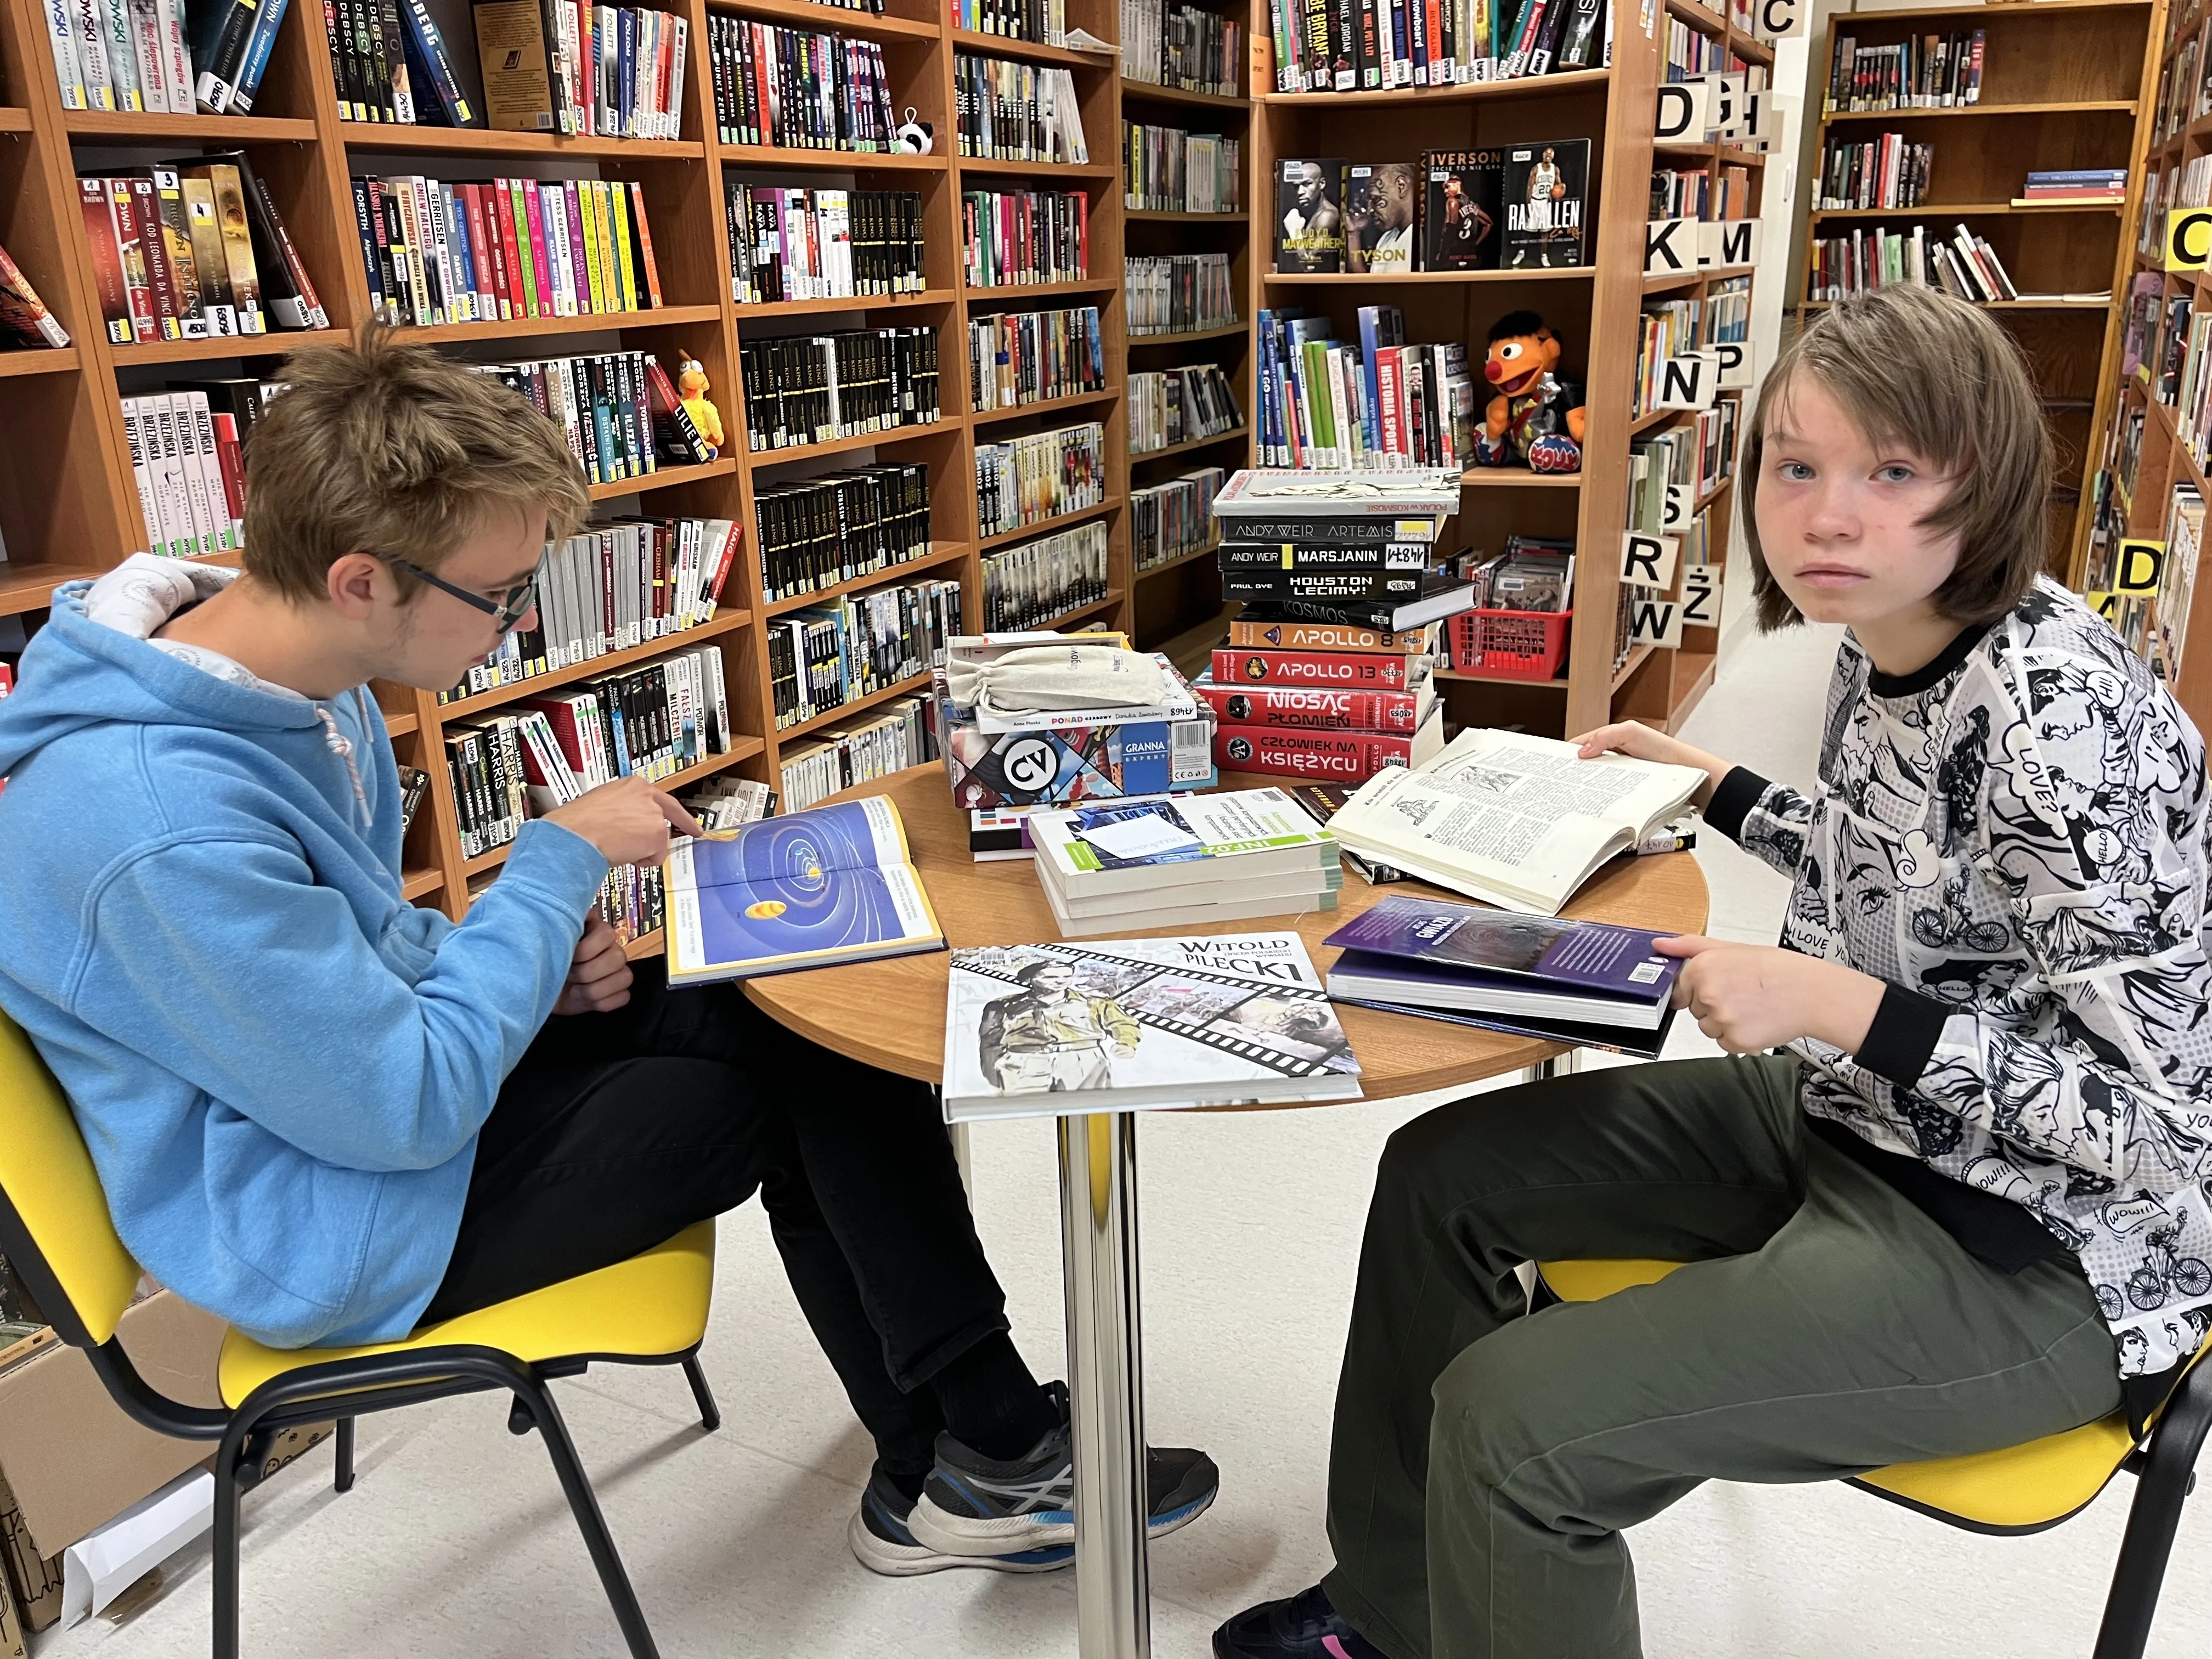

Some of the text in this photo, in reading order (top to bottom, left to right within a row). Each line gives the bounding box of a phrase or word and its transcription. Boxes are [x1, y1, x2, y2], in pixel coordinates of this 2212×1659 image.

[567, 9, 578, 45] FOLLETT
[606, 13, 615, 49] FOLLETT
[1762, 0, 1796, 33] C
[1312, 13, 1329, 55] BRYANT
[746, 71, 755, 111] BLIZNY
[717, 96, 726, 121] ZERO
[1655, 86, 1694, 138] D
[1430, 151, 1501, 166] IVERSON
[356, 189, 369, 230] FORSYTH
[415, 183, 433, 250] GNIEW HALNEGO
[1538, 200, 1581, 229] ALLEN
[430, 193, 447, 245] GERRITSEN
[442, 268, 455, 306] ODWROTU
[557, 217, 568, 258] GERRITSEN
[1646, 221, 1684, 270] K
[1723, 222, 1751, 263] M
[2171, 212, 2212, 265] C
[146, 222, 171, 315] KOD LEONARDA DA VINCI
[453, 255, 464, 286] DAWCA
[1351, 249, 1406, 262] TYSON
[1714, 346, 1742, 383] P
[1380, 365, 1396, 417] HISTORIA
[1662, 361, 1701, 403] N
[142, 415, 162, 461] BRZEZIŃSKA
[157, 413, 178, 459] BRZEZIŃSKA
[176, 411, 196, 456] BRZEZIŃSKA
[195, 410, 215, 455] BRZEZIŃSKA
[624, 414, 637, 454] ILUZJA
[674, 405, 697, 440] LILIE
[568, 428, 577, 454] NA PSY
[572, 421, 584, 460] POLOWANIE
[1365, 503, 1448, 512] POLAK KOSMOSIE
[726, 527, 740, 555] HAIG
[1235, 524, 1393, 537] ANDY WEIR ARTEMIS
[691, 543, 701, 570] GRISHAM
[1231, 550, 1378, 562] ANDY WEIR MARSJANIN
[1623, 537, 1663, 582] R
[2119, 545, 2163, 590] D
[1289, 576, 1373, 585] HOUSTON
[1294, 586, 1367, 596] LECIMY!
[1283, 600, 1349, 625] KOSMOS
[1633, 603, 1674, 639] W
[1292, 629, 1394, 647] APOLLO 8
[1277, 662, 1376, 679] APOLLO 13
[669, 692, 682, 742] MILCZENIE
[680, 688, 692, 720] FAŁSZ
[1170, 707, 1194, 716] 17468
[1266, 692, 1351, 715] NIOSĄC
[695, 707, 706, 736] POTWÓR
[1052, 715, 1084, 725] PONAD
[1267, 712, 1351, 728] PŁOMIEŃ
[500, 730, 519, 786] HARRIS
[1125, 741, 1166, 753] GRANNA
[1125, 754, 1166, 762] EXPERT
[1261, 736, 1357, 753] CZŁOWIEK NA
[488, 733, 507, 789] HARRIS
[514, 750, 524, 778] HARRIS
[1010, 747, 1048, 783] CV
[1261, 751, 1357, 772] KSIĘŻYCU
[2019, 747, 2060, 814] LOVE?
[465, 791, 475, 820] HARRIS
[475, 788, 486, 816] HARRIS
[483, 784, 494, 812] HARRIS
[1203, 839, 1270, 855] INF.02
[2097, 828, 2109, 865] HELLO!
[1178, 940, 1289, 953] WITOLD
[1798, 930, 1829, 950] LOVE
[1184, 954, 1304, 982] PILECKI
[1938, 985, 1973, 993] HELLO!
[2108, 1201, 2155, 1226] WOW!!!
